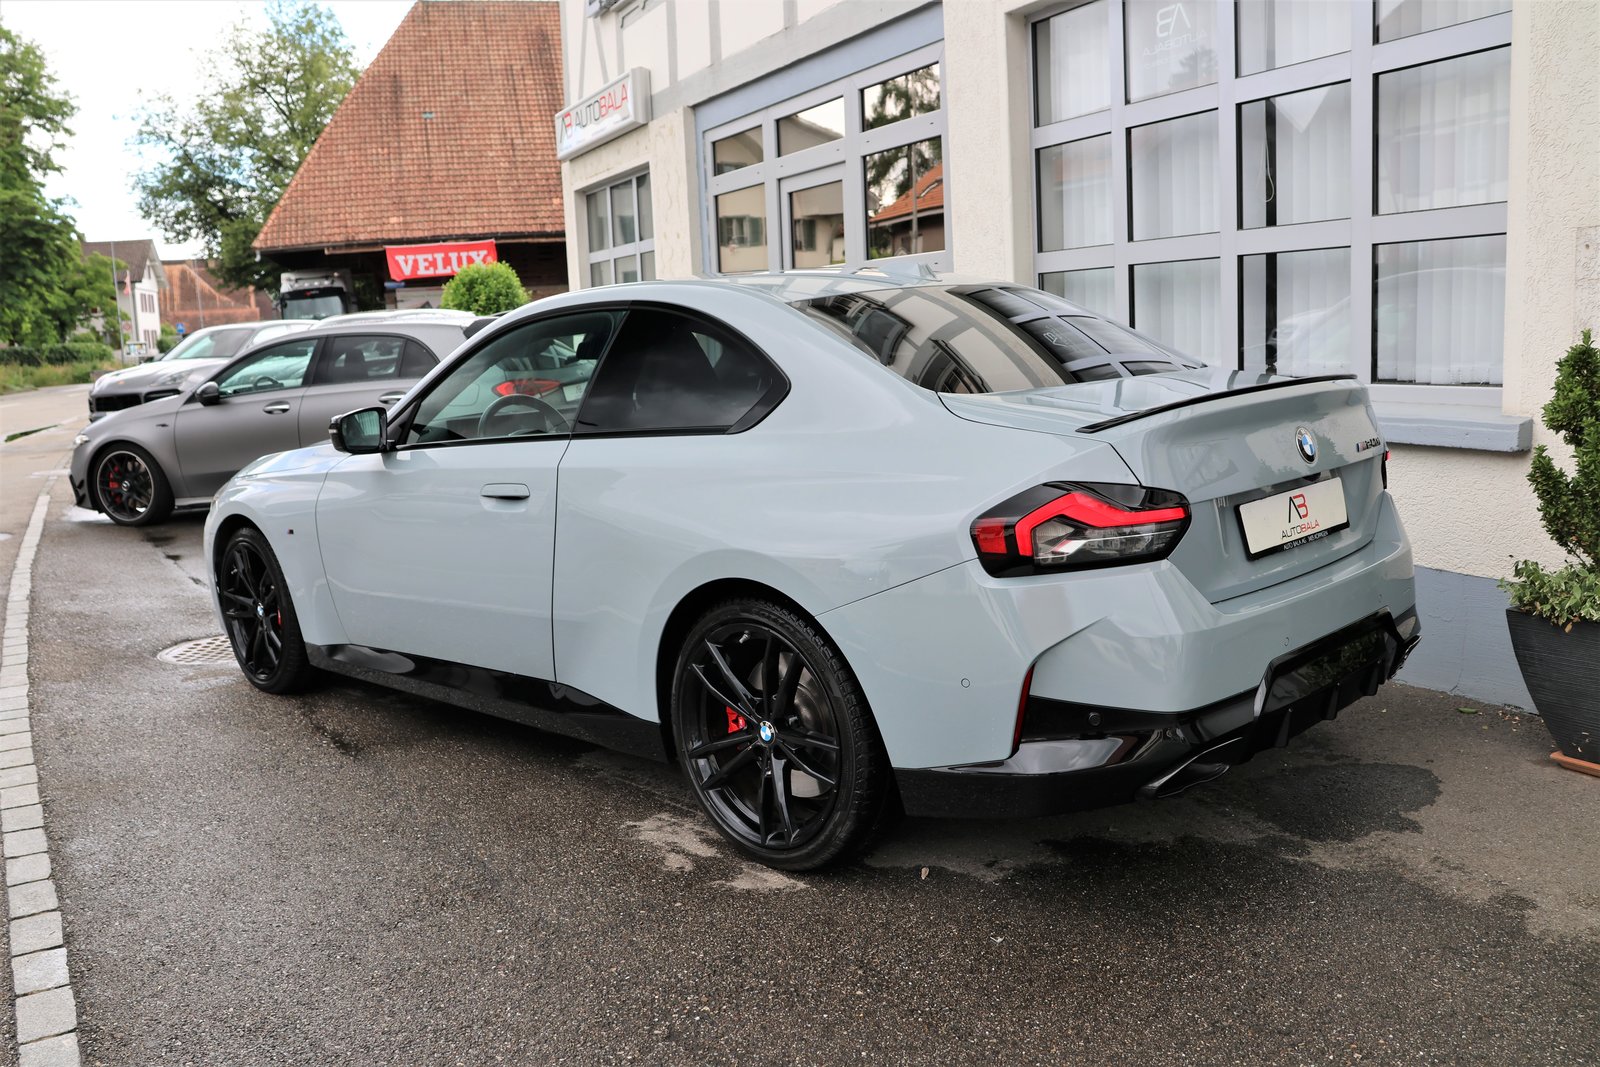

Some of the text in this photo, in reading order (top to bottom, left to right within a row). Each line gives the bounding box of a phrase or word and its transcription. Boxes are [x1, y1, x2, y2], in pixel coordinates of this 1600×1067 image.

[575, 83, 628, 128] AUTOBALA
[395, 250, 487, 276] VELUX
[1281, 519, 1320, 540] AUTOBALA
